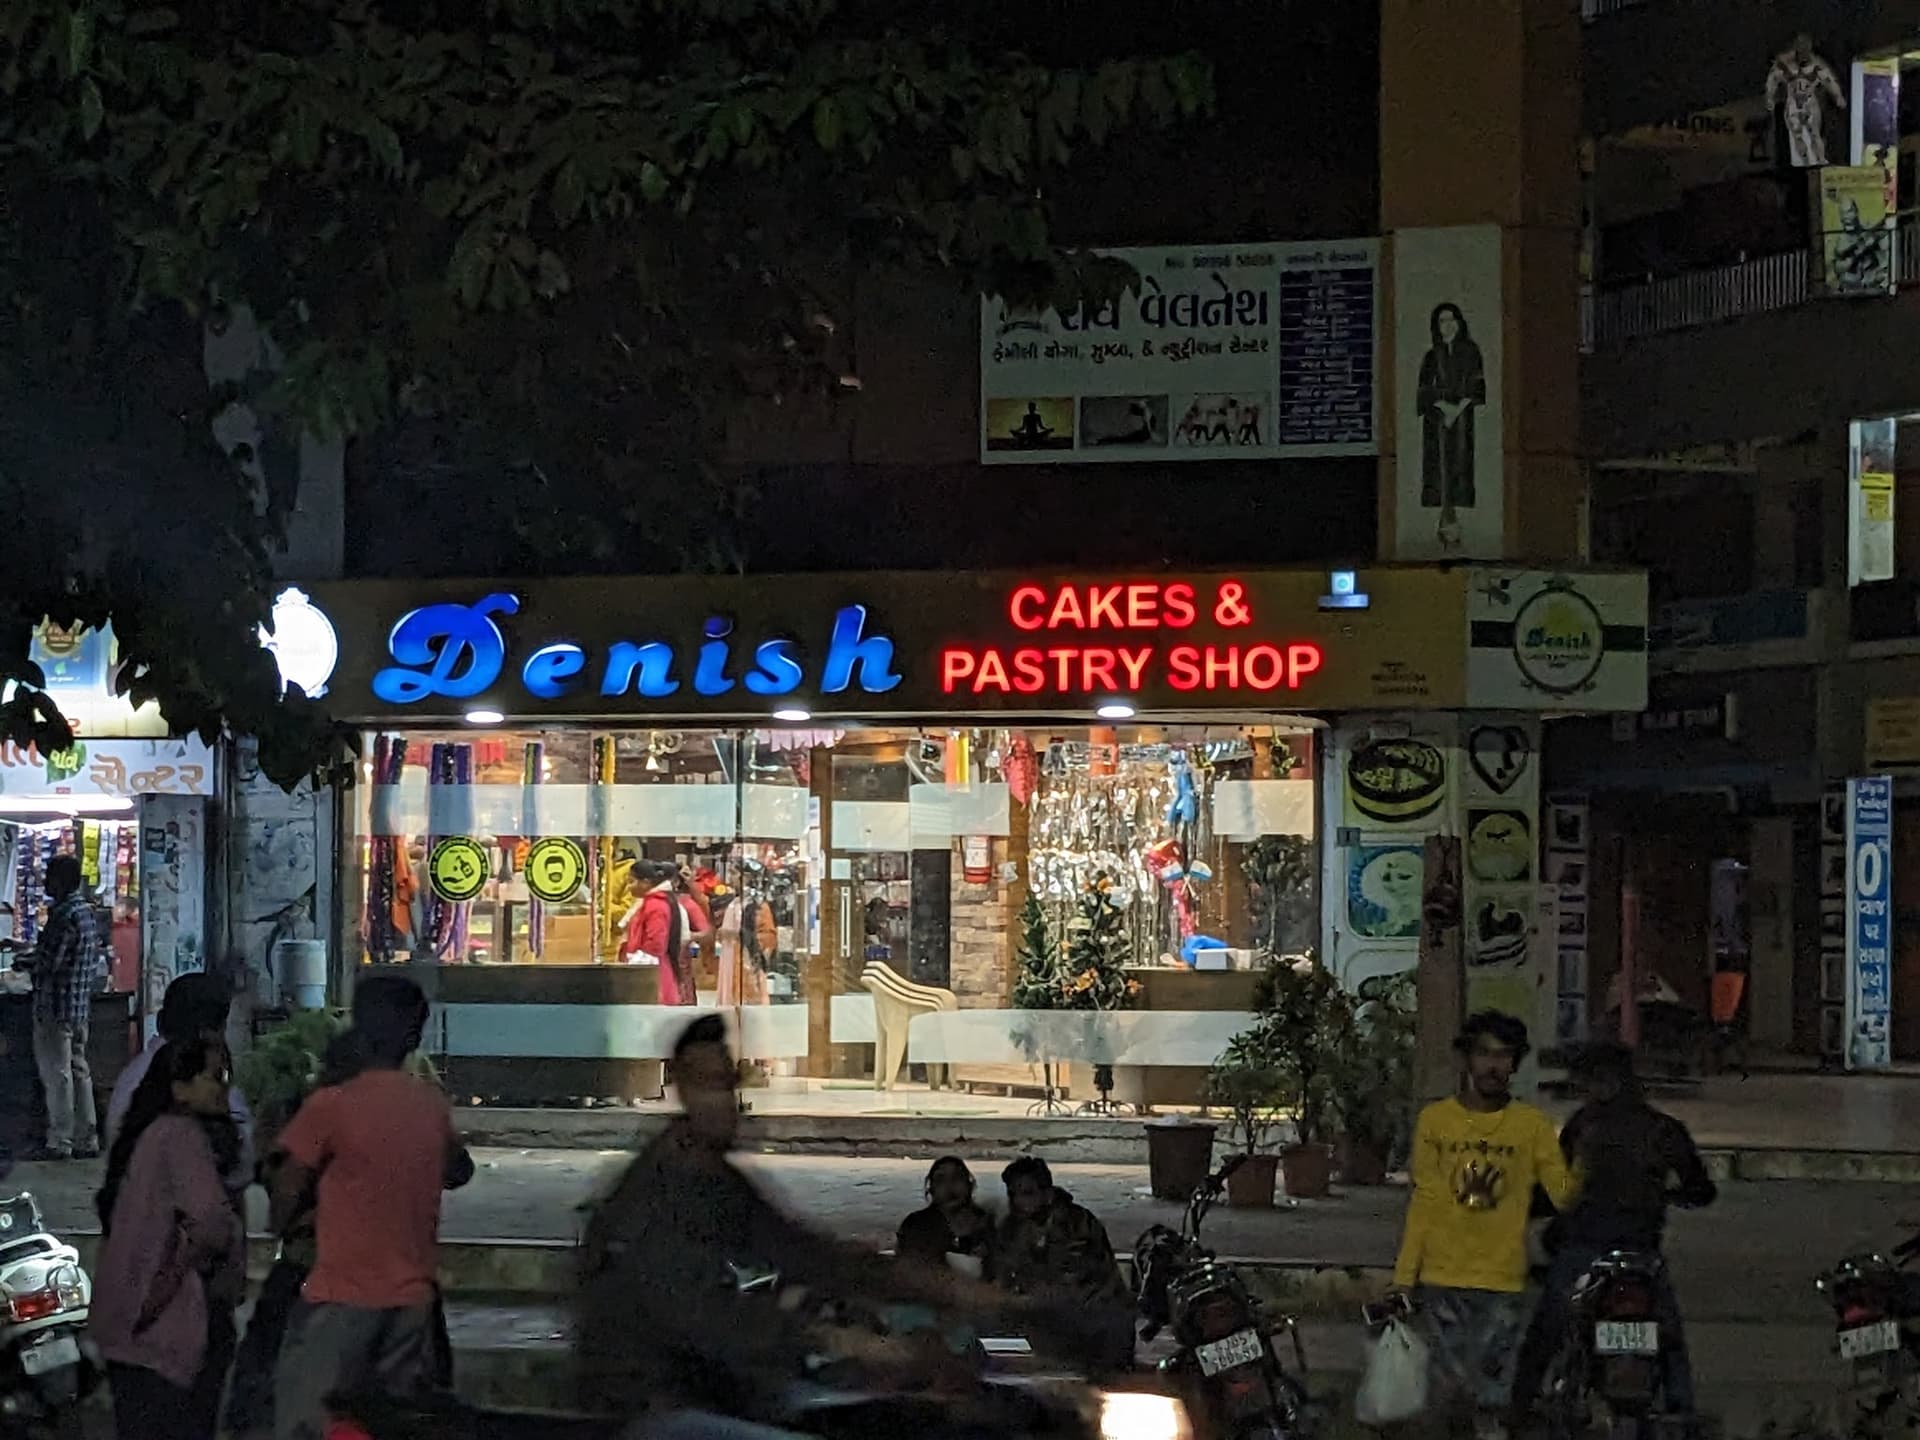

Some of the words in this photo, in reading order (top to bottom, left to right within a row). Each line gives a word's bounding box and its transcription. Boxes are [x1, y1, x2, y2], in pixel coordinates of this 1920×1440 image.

[1140, 272, 1268, 328] વેલનેશ
[1010, 584, 1196, 630] CAKES
[1214, 582, 1251, 627] &
[372, 592, 902, 704] Denish
[943, 647, 1154, 694] PASTRY
[1166, 644, 1321, 690] SHOP
